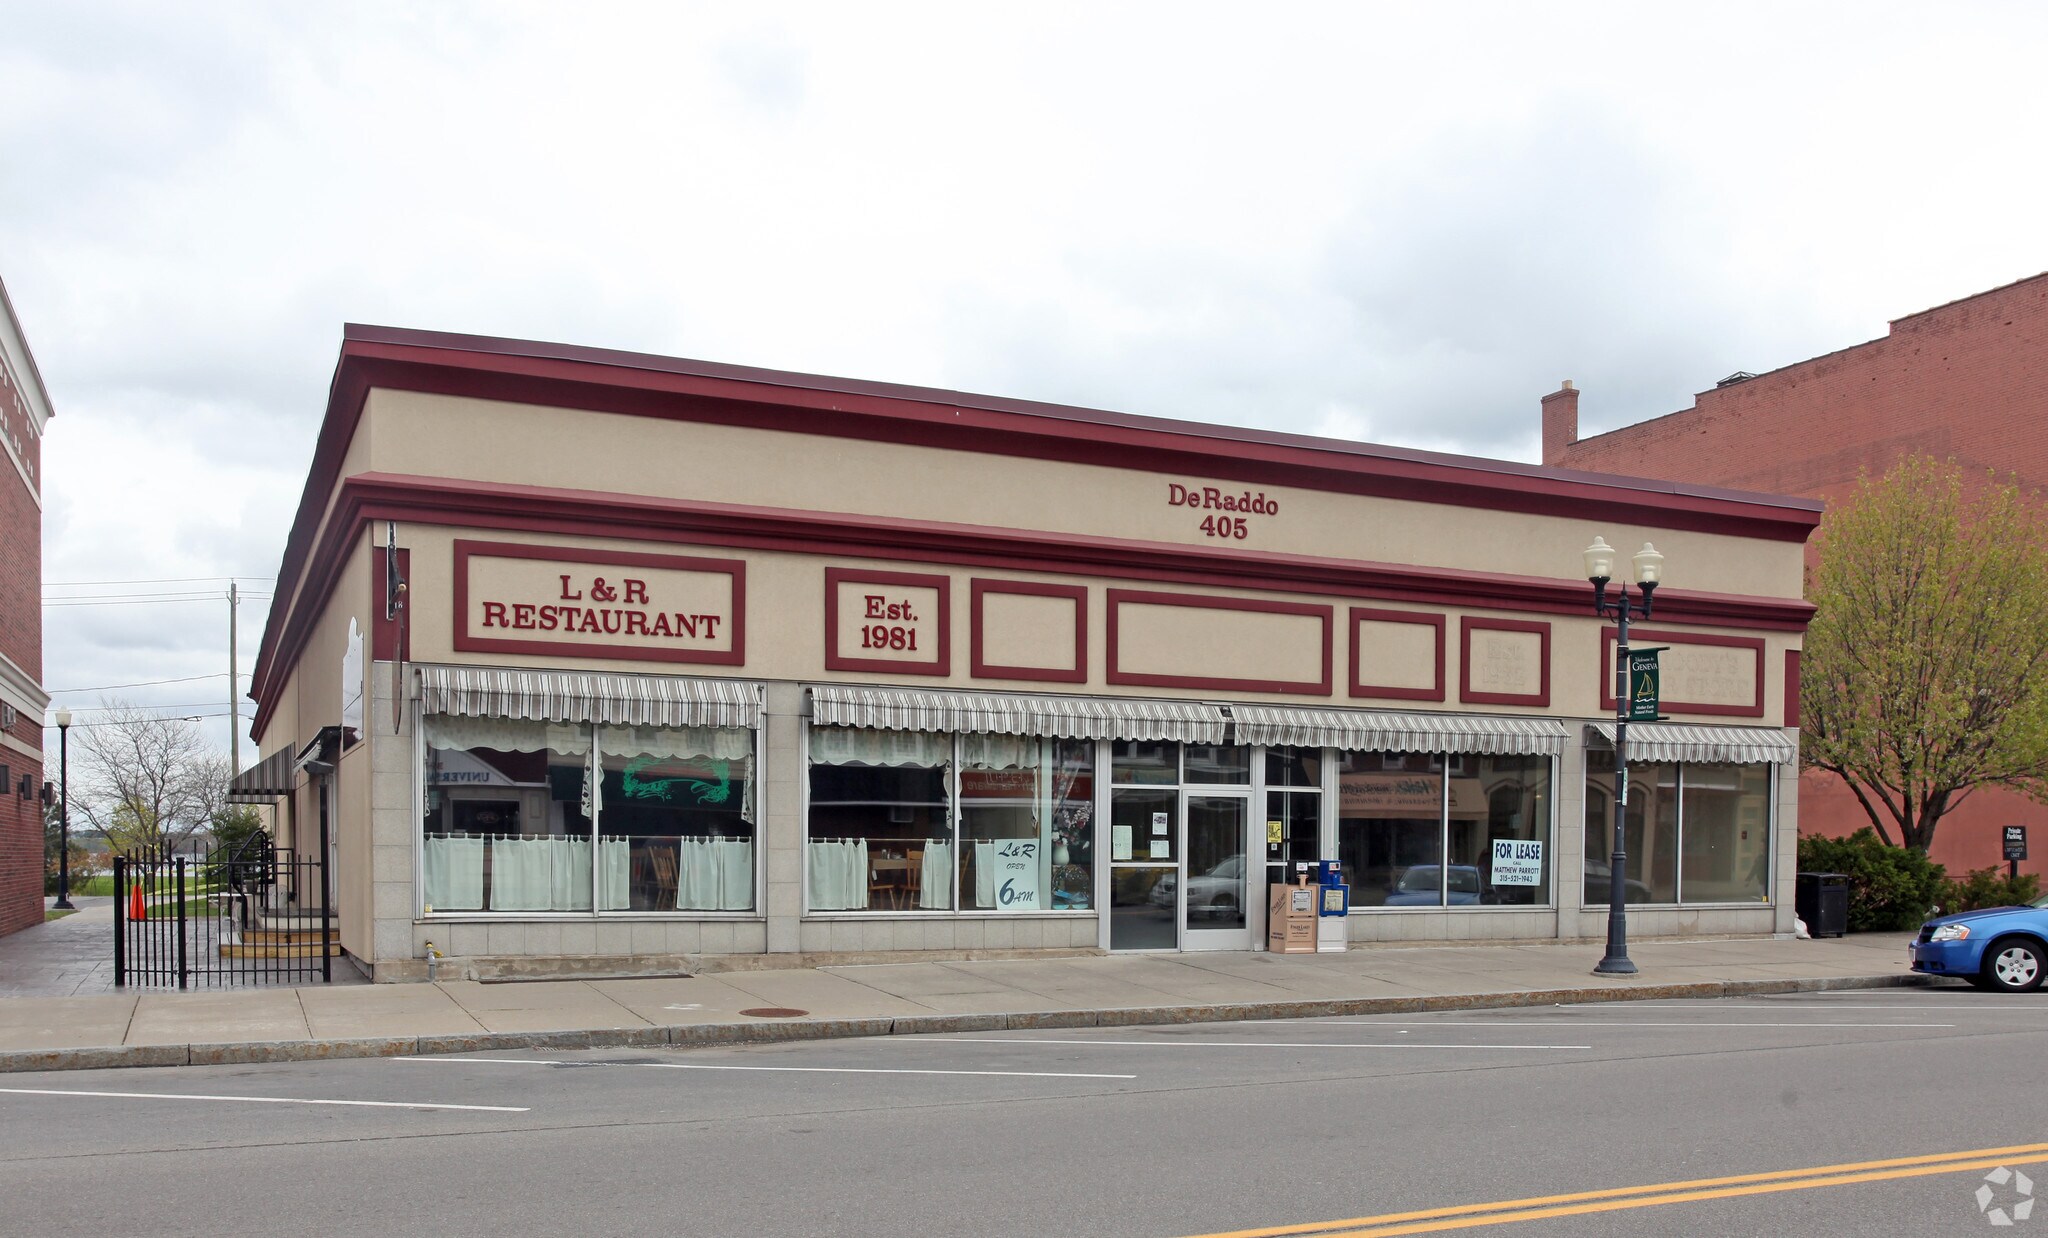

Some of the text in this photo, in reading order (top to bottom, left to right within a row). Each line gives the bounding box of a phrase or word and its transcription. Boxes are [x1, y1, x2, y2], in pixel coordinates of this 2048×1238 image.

[1168, 484, 1280, 516] DeRaddo
[1199, 515, 1248, 540] 405
[482, 602, 721, 639] RESTAURANT
[864, 595, 919, 622] Est.
[861, 625, 918, 652] 1981
[1632, 662, 1658, 671] GENEVA
[1495, 843, 1540, 859] FOR LEASE
[1006, 862, 1026, 870] OPEN
[1494, 866, 1539, 875] MATTHEW PARROTT
